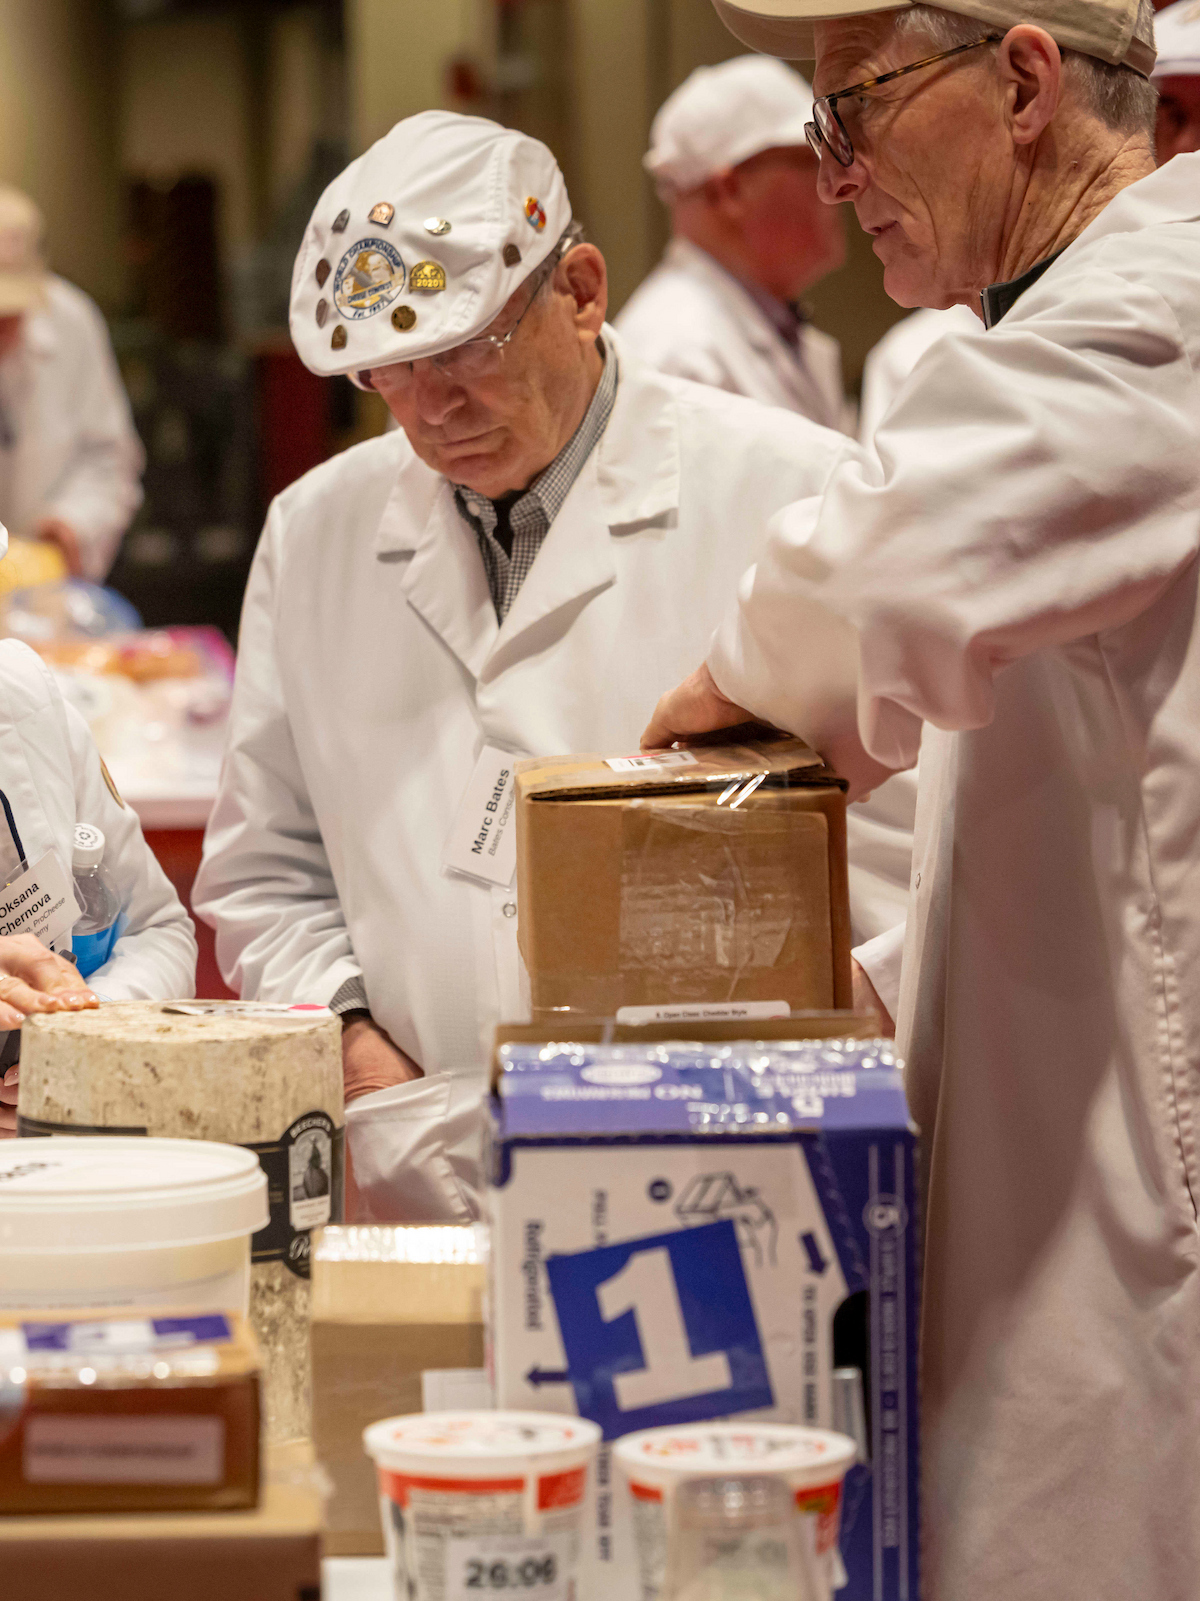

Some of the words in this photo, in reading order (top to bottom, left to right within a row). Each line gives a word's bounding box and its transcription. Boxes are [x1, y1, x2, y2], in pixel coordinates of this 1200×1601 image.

[416, 278, 439, 288] 2020
[471, 817, 493, 854] Marc
[485, 769, 510, 813] Bates
[488, 829, 503, 856] Bates
[0, 893, 51, 937] Chernova
[33, 897, 66, 927] ProCheese
[595, 1246, 733, 1412] 1
